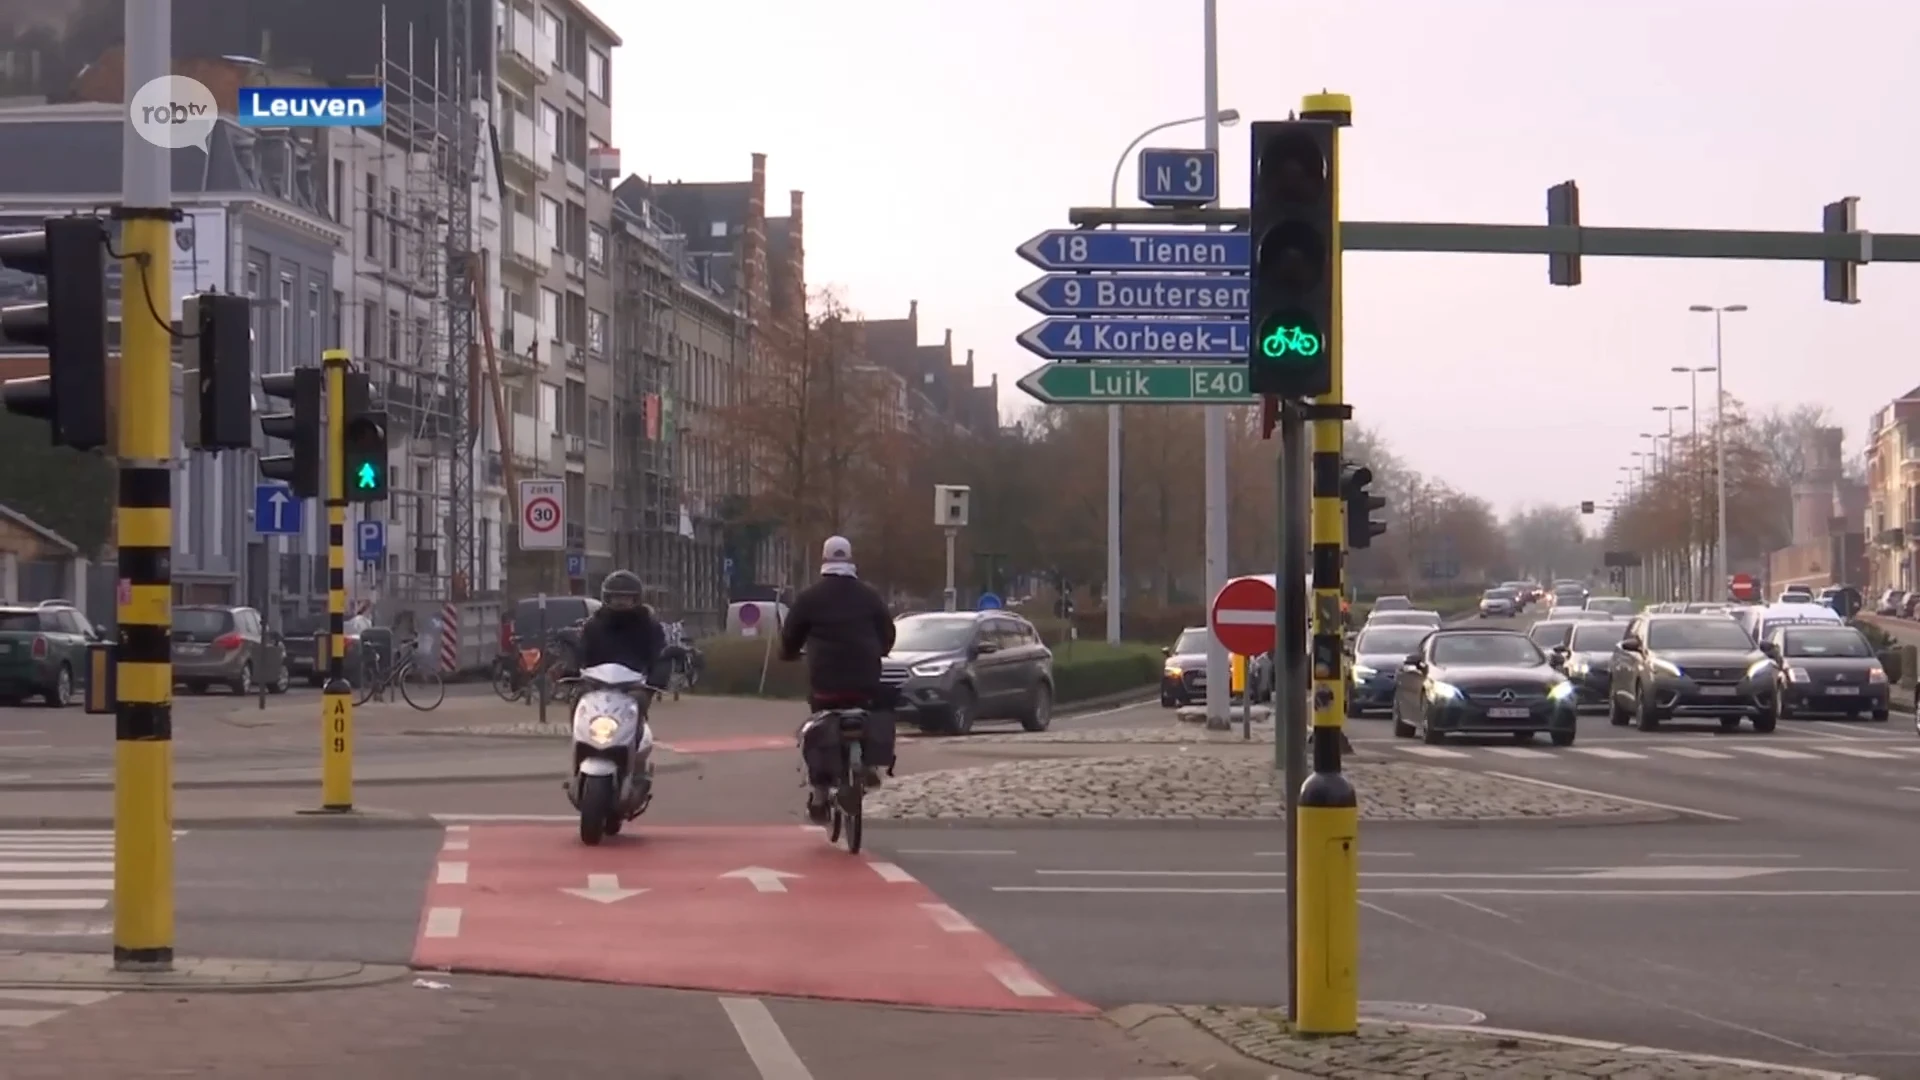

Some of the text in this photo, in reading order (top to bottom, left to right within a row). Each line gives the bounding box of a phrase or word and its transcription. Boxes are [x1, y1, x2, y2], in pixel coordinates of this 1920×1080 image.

[1157, 157, 1202, 192] N 3
[1057, 235, 1226, 262] 18 Tienen
[1063, 280, 1082, 306] 9
[1063, 324, 1250, 352] 4 Korbeek-L
[1090, 369, 1243, 395] Luik E40
[530, 486, 554, 494] ZONE
[533, 508, 553, 521] 30
[360, 523, 379, 551] P
